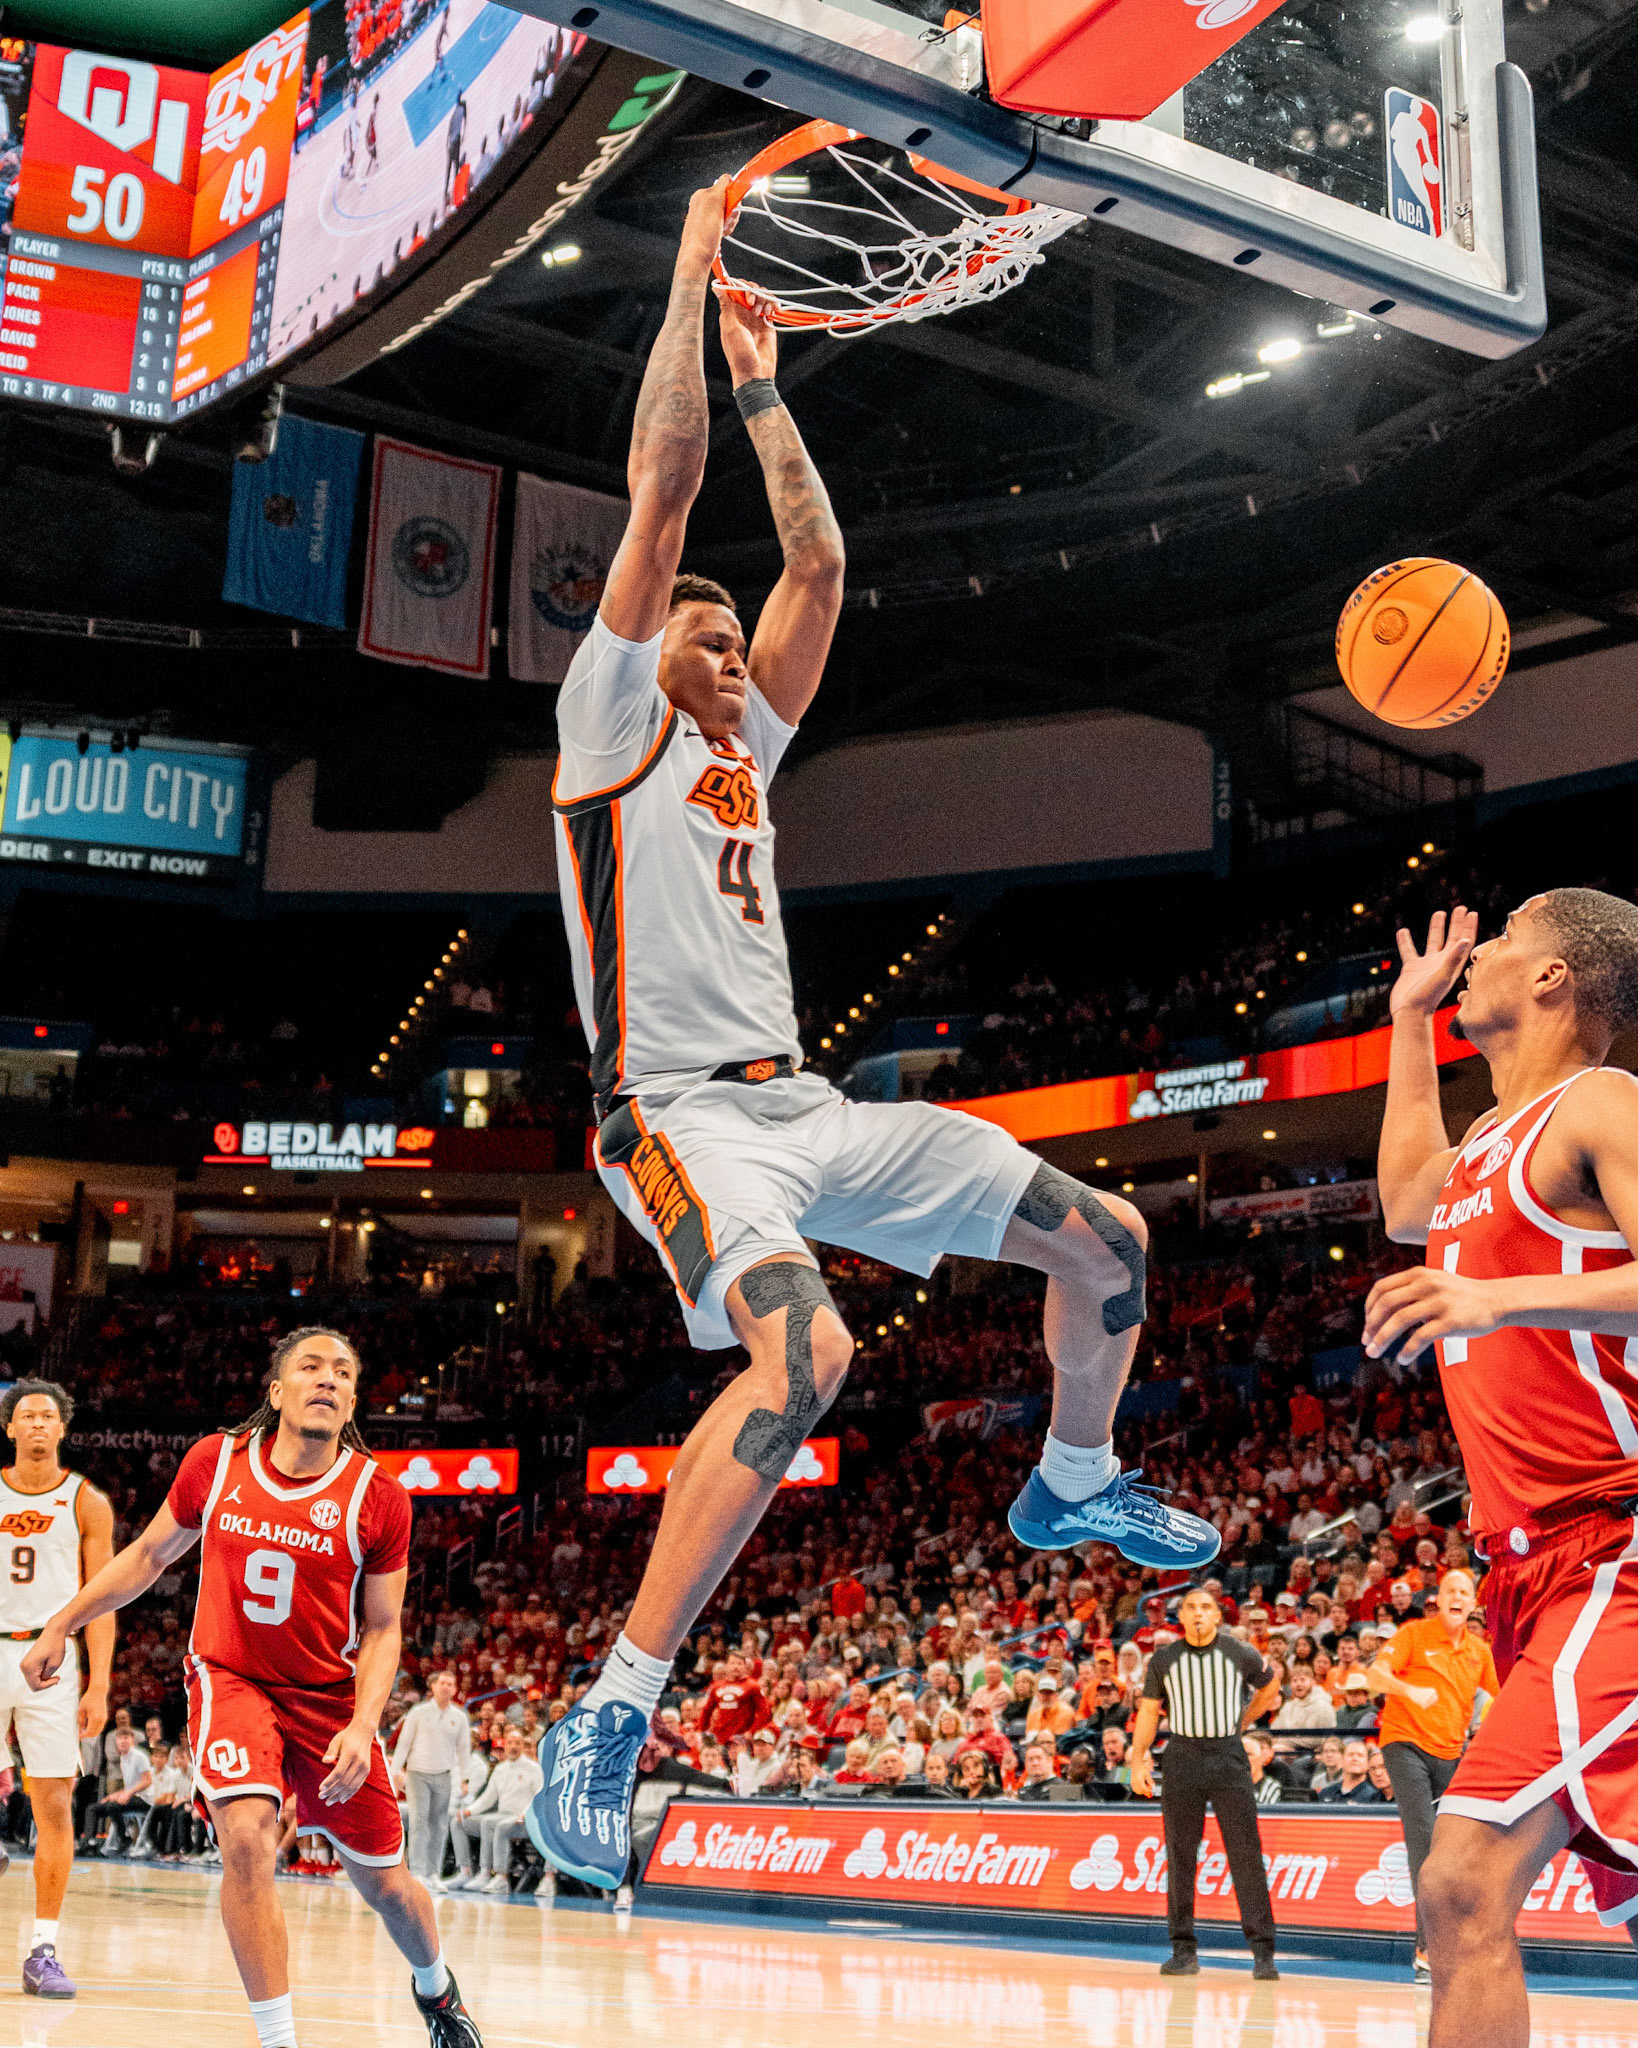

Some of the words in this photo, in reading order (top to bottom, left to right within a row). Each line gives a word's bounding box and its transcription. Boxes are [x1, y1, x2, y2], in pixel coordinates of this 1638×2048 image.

[200, 21, 309, 154] OSU
[67, 165, 145, 241] 50
[219, 146, 267, 226] 49
[1397, 198, 1424, 229] NBA
[9, 258, 56, 281] BROWN
[145, 283, 163, 300] 10
[170, 287, 178, 302] 1
[14, 236, 60, 259] PLAYER
[142, 259, 166, 277] PTS
[167, 263, 184, 281] FL
[6, 281, 40, 302] PACK
[143, 306, 159, 322] 15
[167, 310, 176, 325] 1
[3, 305, 41, 326] JONES
[165, 333, 173, 347] 1
[0, 328, 37, 348] DAVIS
[139, 353, 149, 368] 2
[162, 356, 170, 371] 1
[3, 376, 20, 393] TO
[25, 381, 34, 396] 3
[42, 385, 56, 400] TF
[62, 388, 73, 402] 4
[91, 392, 117, 409] 2ND
[130, 399, 164, 418] 12:15
[157, 379, 168, 395] 0
[16, 757, 129, 821] LOUD
[143, 762, 235, 840] CITY
[685, 764, 759, 830] OSU
[87, 848, 144, 870] EXIT
[150, 854, 208, 876] NOW
[717, 837, 764, 925] 4
[746, 1059, 776, 1081] OSU
[1155, 1065, 1226, 1089] PRESENTED
[1226, 1060, 1245, 1078] BY
[242, 1122, 397, 1157] BEDLAM
[271, 1155, 364, 1171] BASKETBALL
[631, 1137, 689, 1236] COWBYS
[1427, 1186, 1494, 1231] KLAHOMA
[0, 1510, 55, 1538] OSU
[219, 1513, 335, 1557] OKLAHOMA
[313, 1503, 338, 1527] SEC
[10, 1546, 36, 1585] 9
[242, 1549, 296, 1627] 9
[207, 1739, 251, 1780] OU
